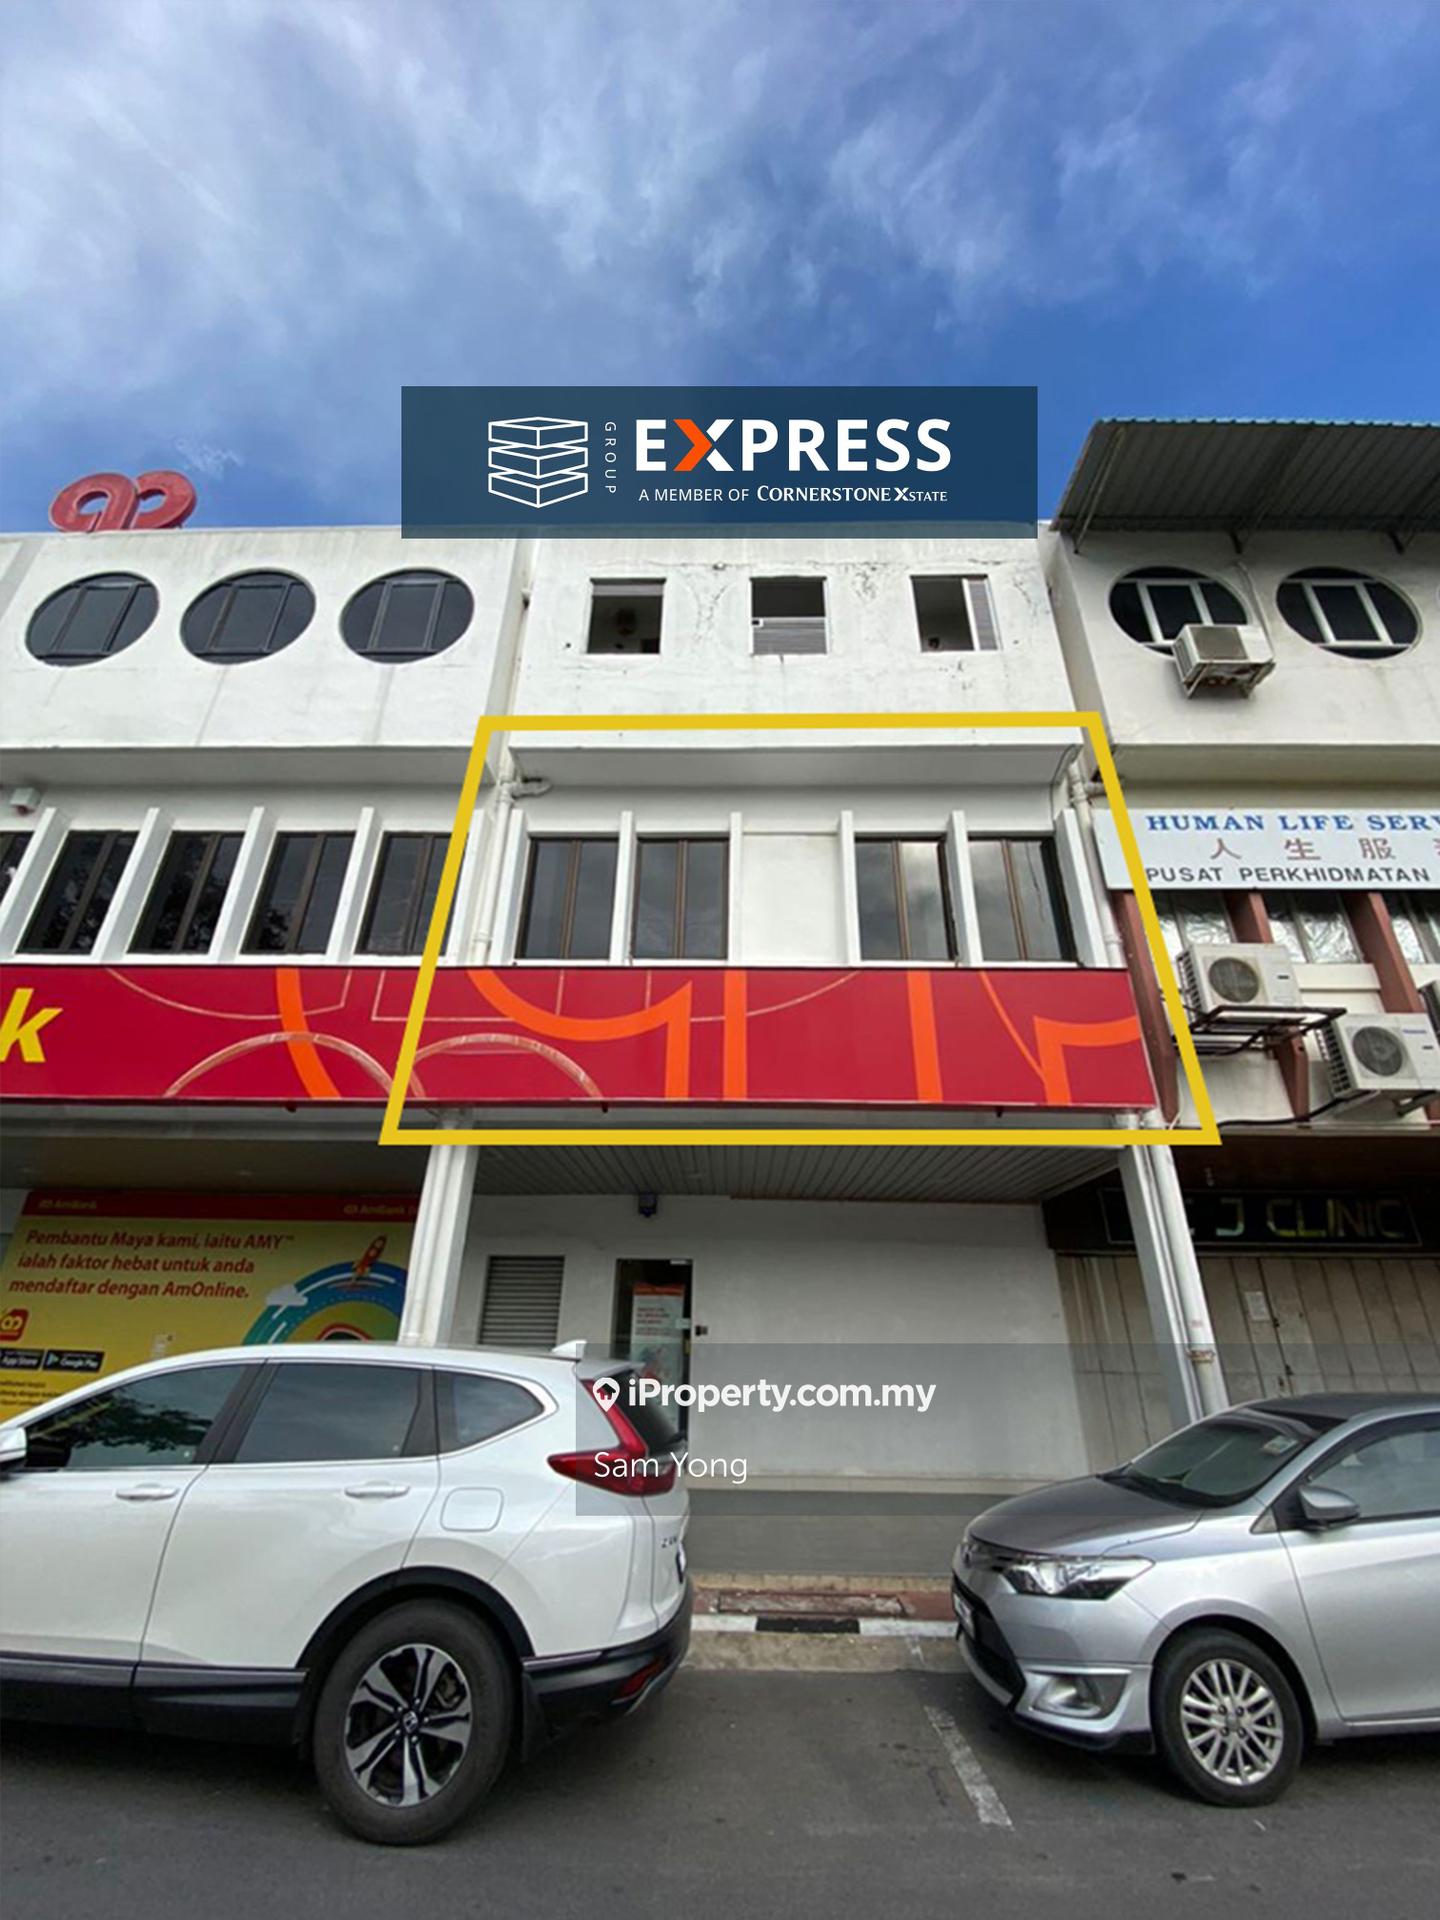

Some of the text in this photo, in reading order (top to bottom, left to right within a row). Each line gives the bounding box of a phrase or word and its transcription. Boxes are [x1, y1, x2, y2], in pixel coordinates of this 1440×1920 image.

[1146, 815, 1265, 831] HUMAN
[1278, 815, 1354, 831] LIFE
[1210, 837, 1440, 861] 人生服
[1146, 867, 1430, 882] PUSAT PERKHIDMATAN
[1266, 1199, 1407, 1237] CLINIC
[26, 1229, 109, 1246] Pembantu
[110, 1232, 153, 1250] Maya
[157, 1233, 201, 1250] kami,
[204, 1234, 242, 1249] iaitu
[17, 1251, 255, 1274] ialah faktor hebat untuk anda
[9, 1277, 249, 1299] mendaftar dengan AmOnline.
